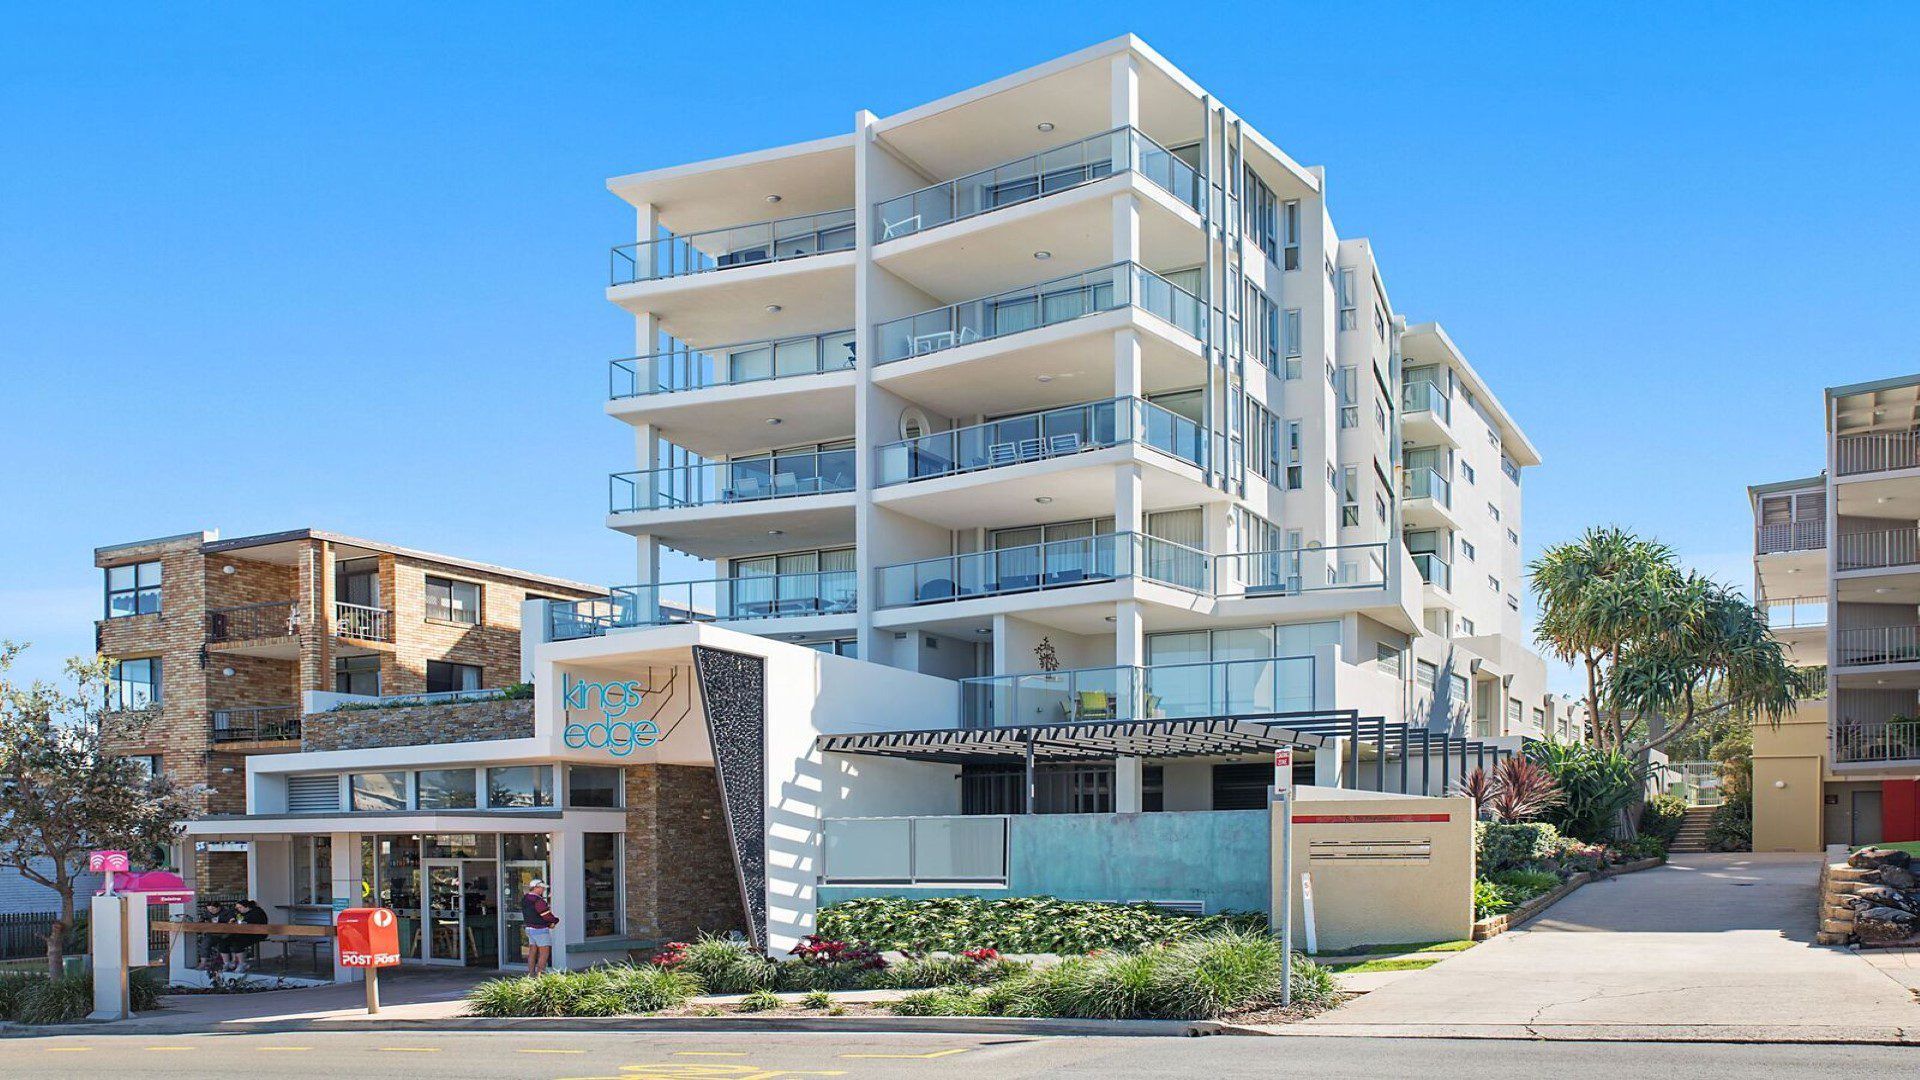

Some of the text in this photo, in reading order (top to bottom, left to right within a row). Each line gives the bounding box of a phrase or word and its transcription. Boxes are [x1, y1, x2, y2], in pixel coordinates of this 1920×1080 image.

[563, 673, 641, 717] kings
[564, 712, 660, 757] edge
[343, 955, 372, 965] POST
[375, 955, 400, 965] POST
